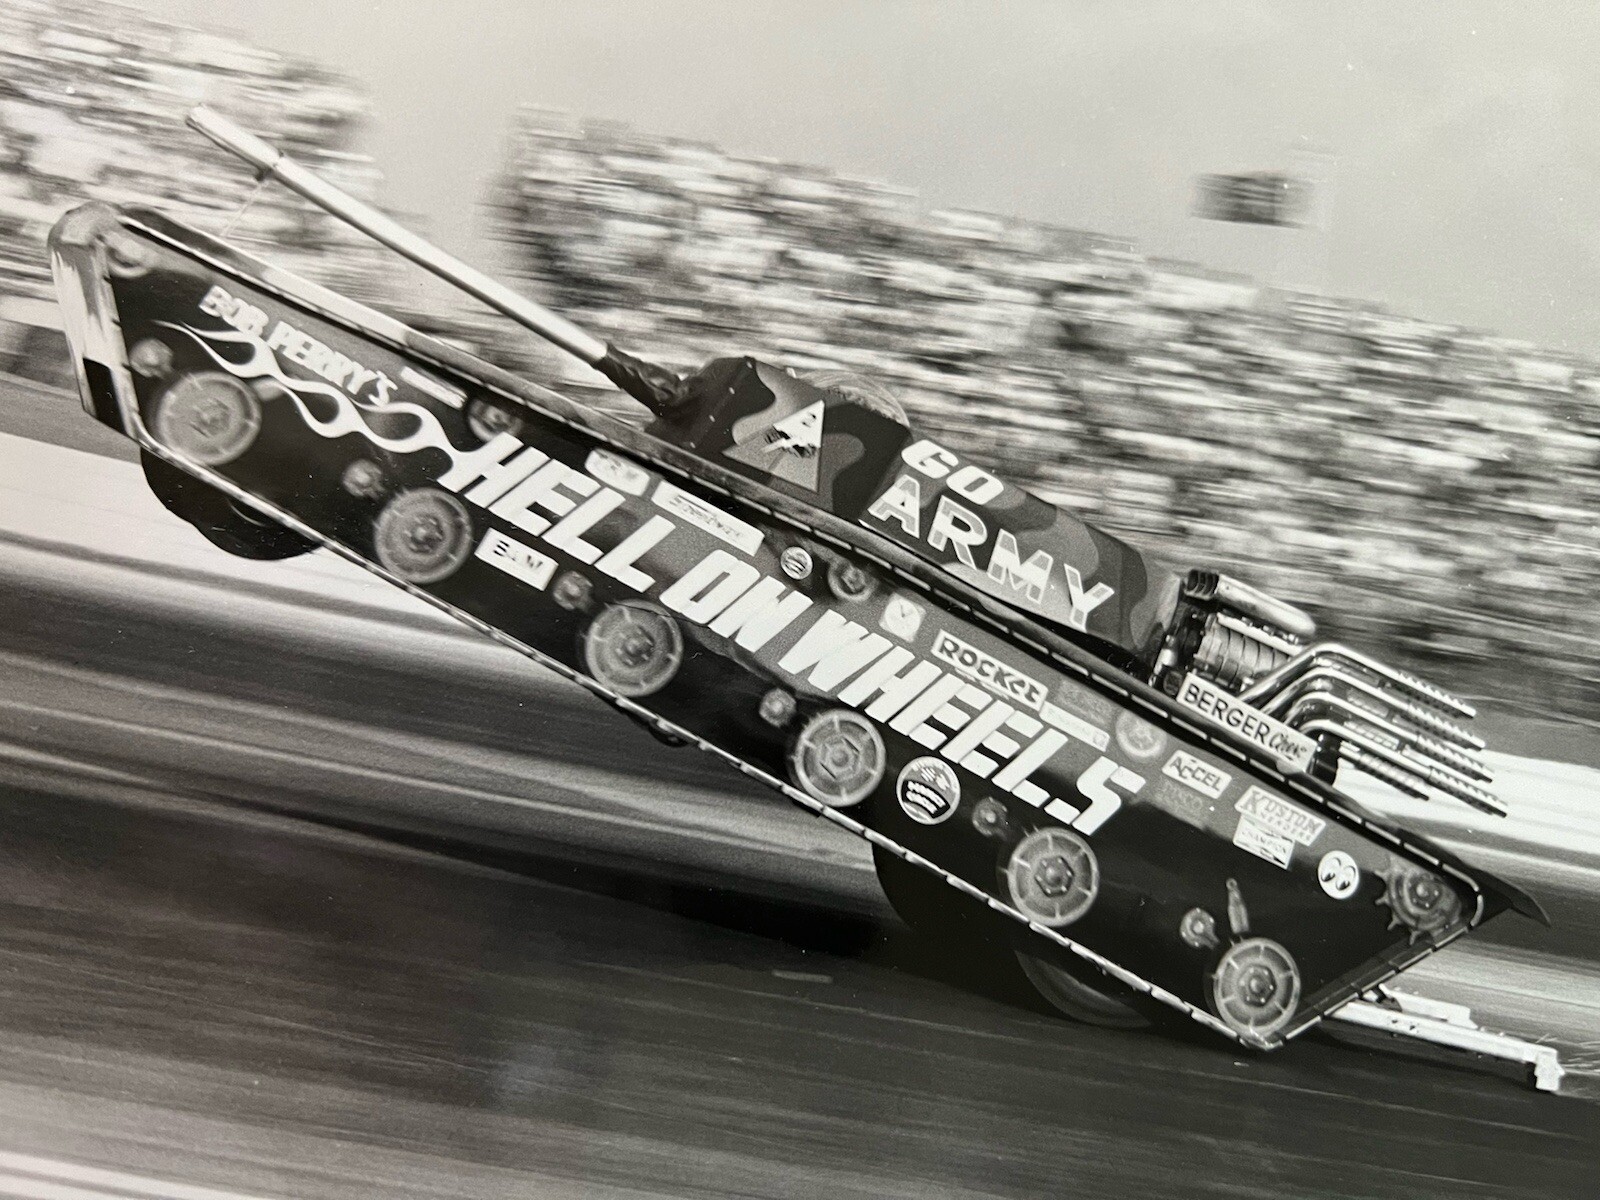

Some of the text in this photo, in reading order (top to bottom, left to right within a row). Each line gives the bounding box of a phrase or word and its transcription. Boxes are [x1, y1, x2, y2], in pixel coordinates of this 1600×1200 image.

[901, 439, 1004, 505] GO
[867, 474, 1114, 632] ARMY
[438, 432, 1146, 835] HELL ON WHEELS
[1184, 683, 1270, 744] BERGER
[1169, 756, 1223, 792] ACCEL
[1239, 789, 1322, 835] KUSTOM
